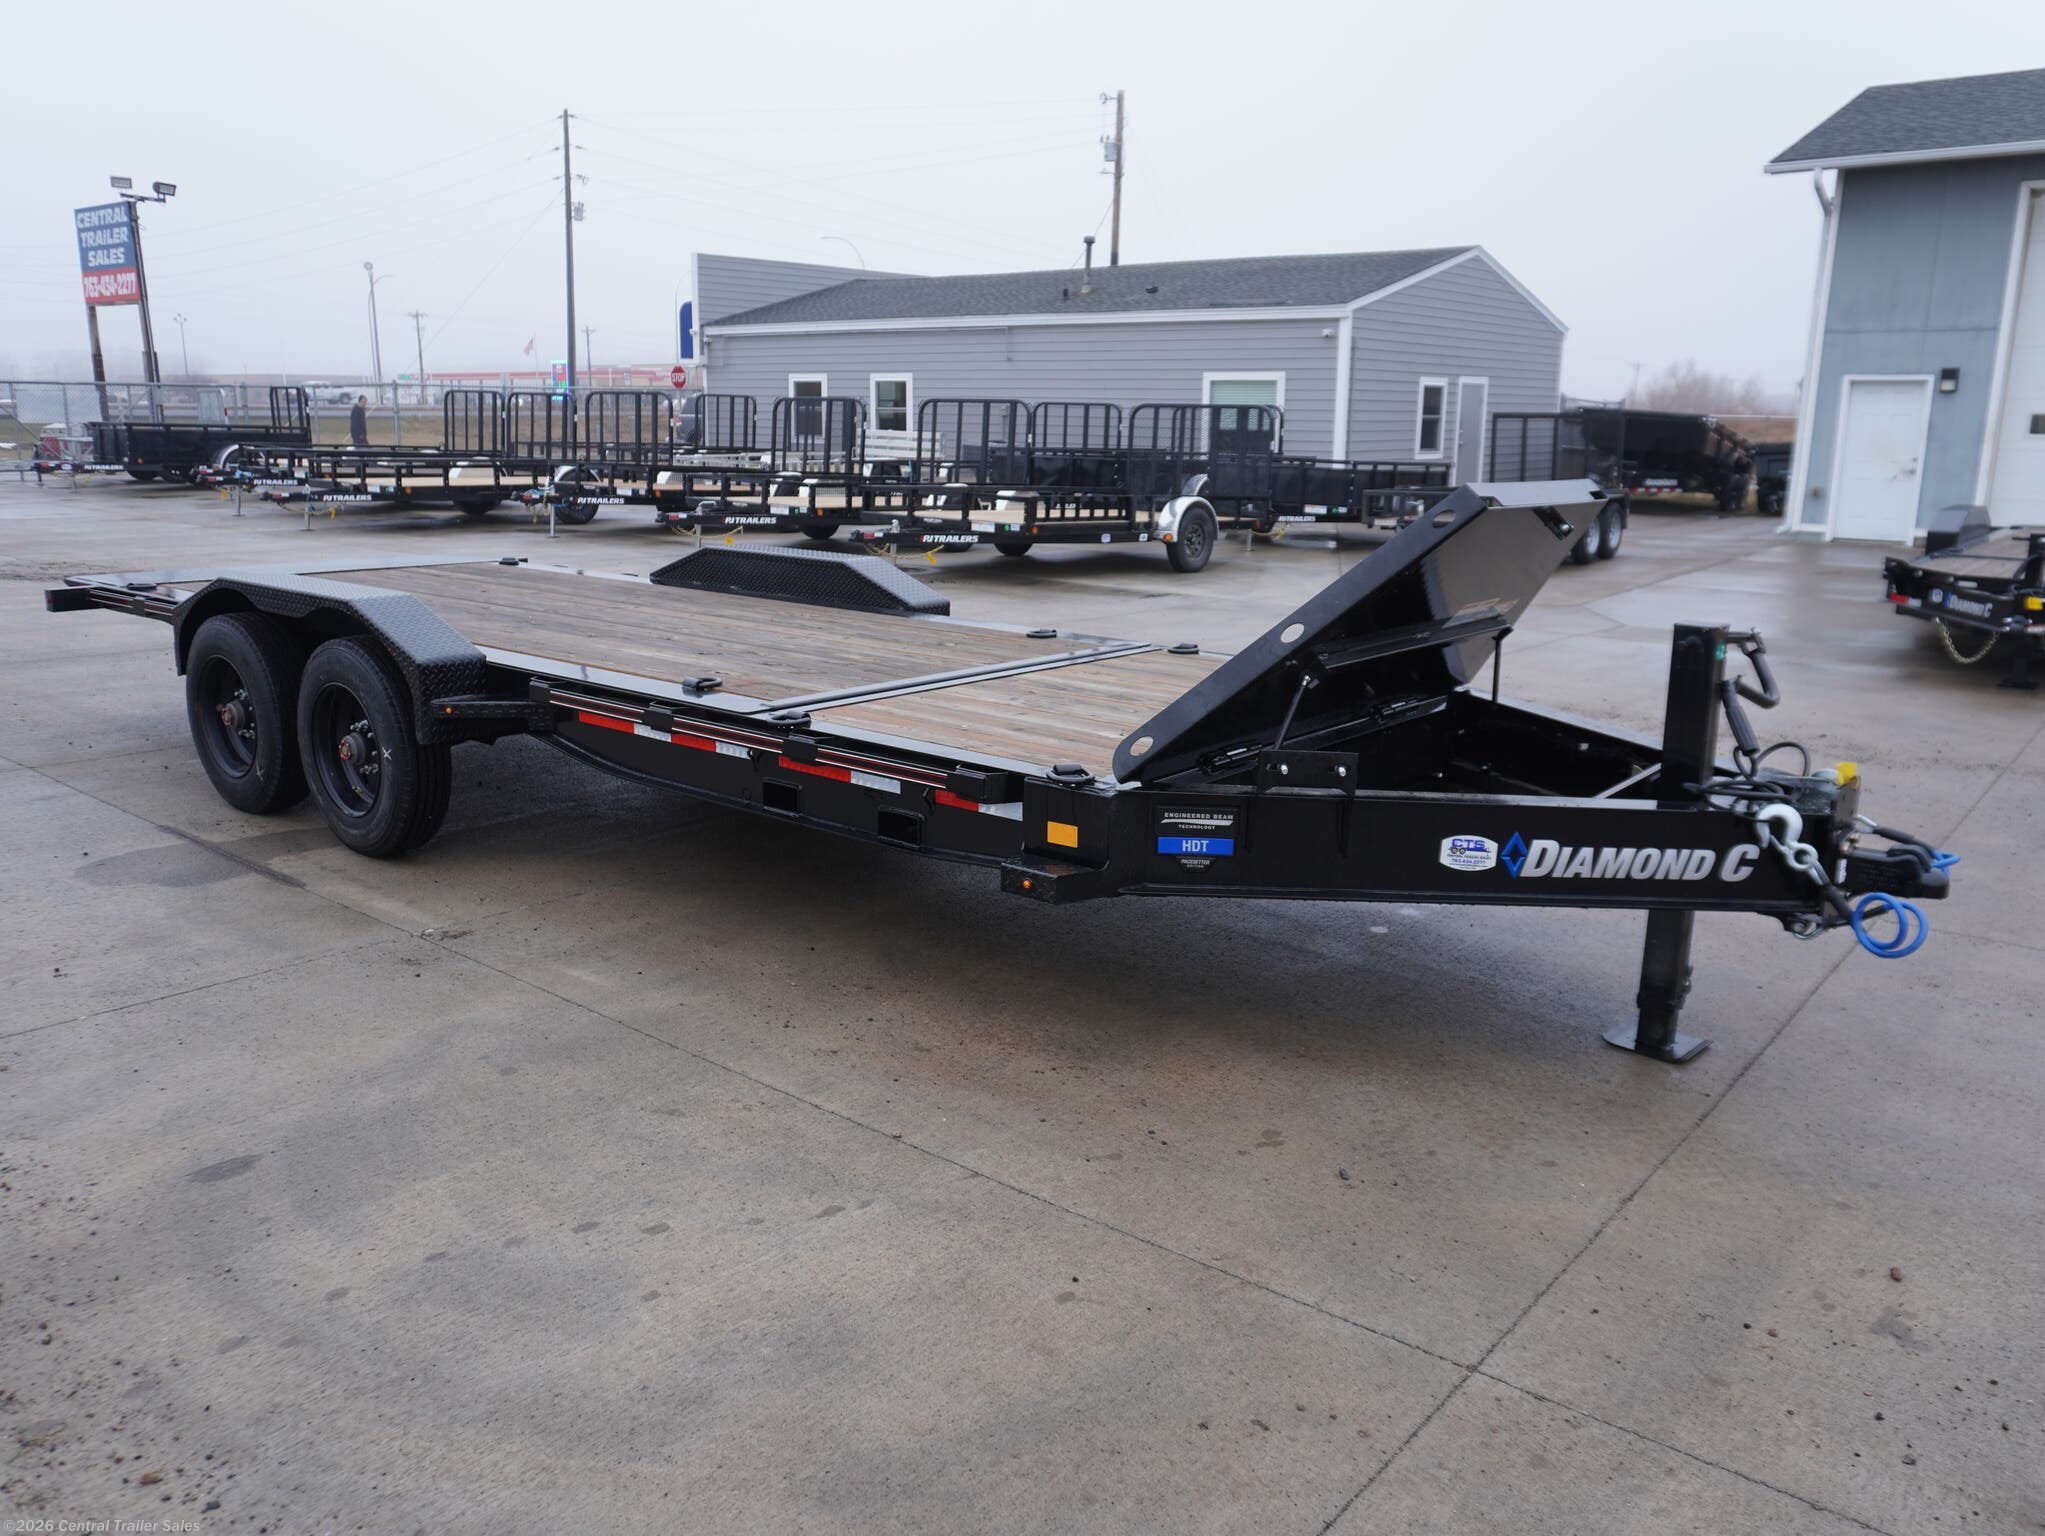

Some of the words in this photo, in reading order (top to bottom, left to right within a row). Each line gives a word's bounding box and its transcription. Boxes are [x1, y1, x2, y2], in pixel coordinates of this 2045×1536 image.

[77, 206, 128, 228] CENTRAL
[81, 226, 129, 248] TRAILER
[88, 247, 125, 267] SALES
[83, 272, 137, 298] 763-434-2277
[671, 372, 687, 383] STOP
[933, 535, 979, 543] TRAILERS
[1182, 839, 1209, 853] HDT
[1452, 838, 1485, 850] CTS
[1520, 839, 1717, 881] DIAMOND
[1719, 843, 1760, 882] C
